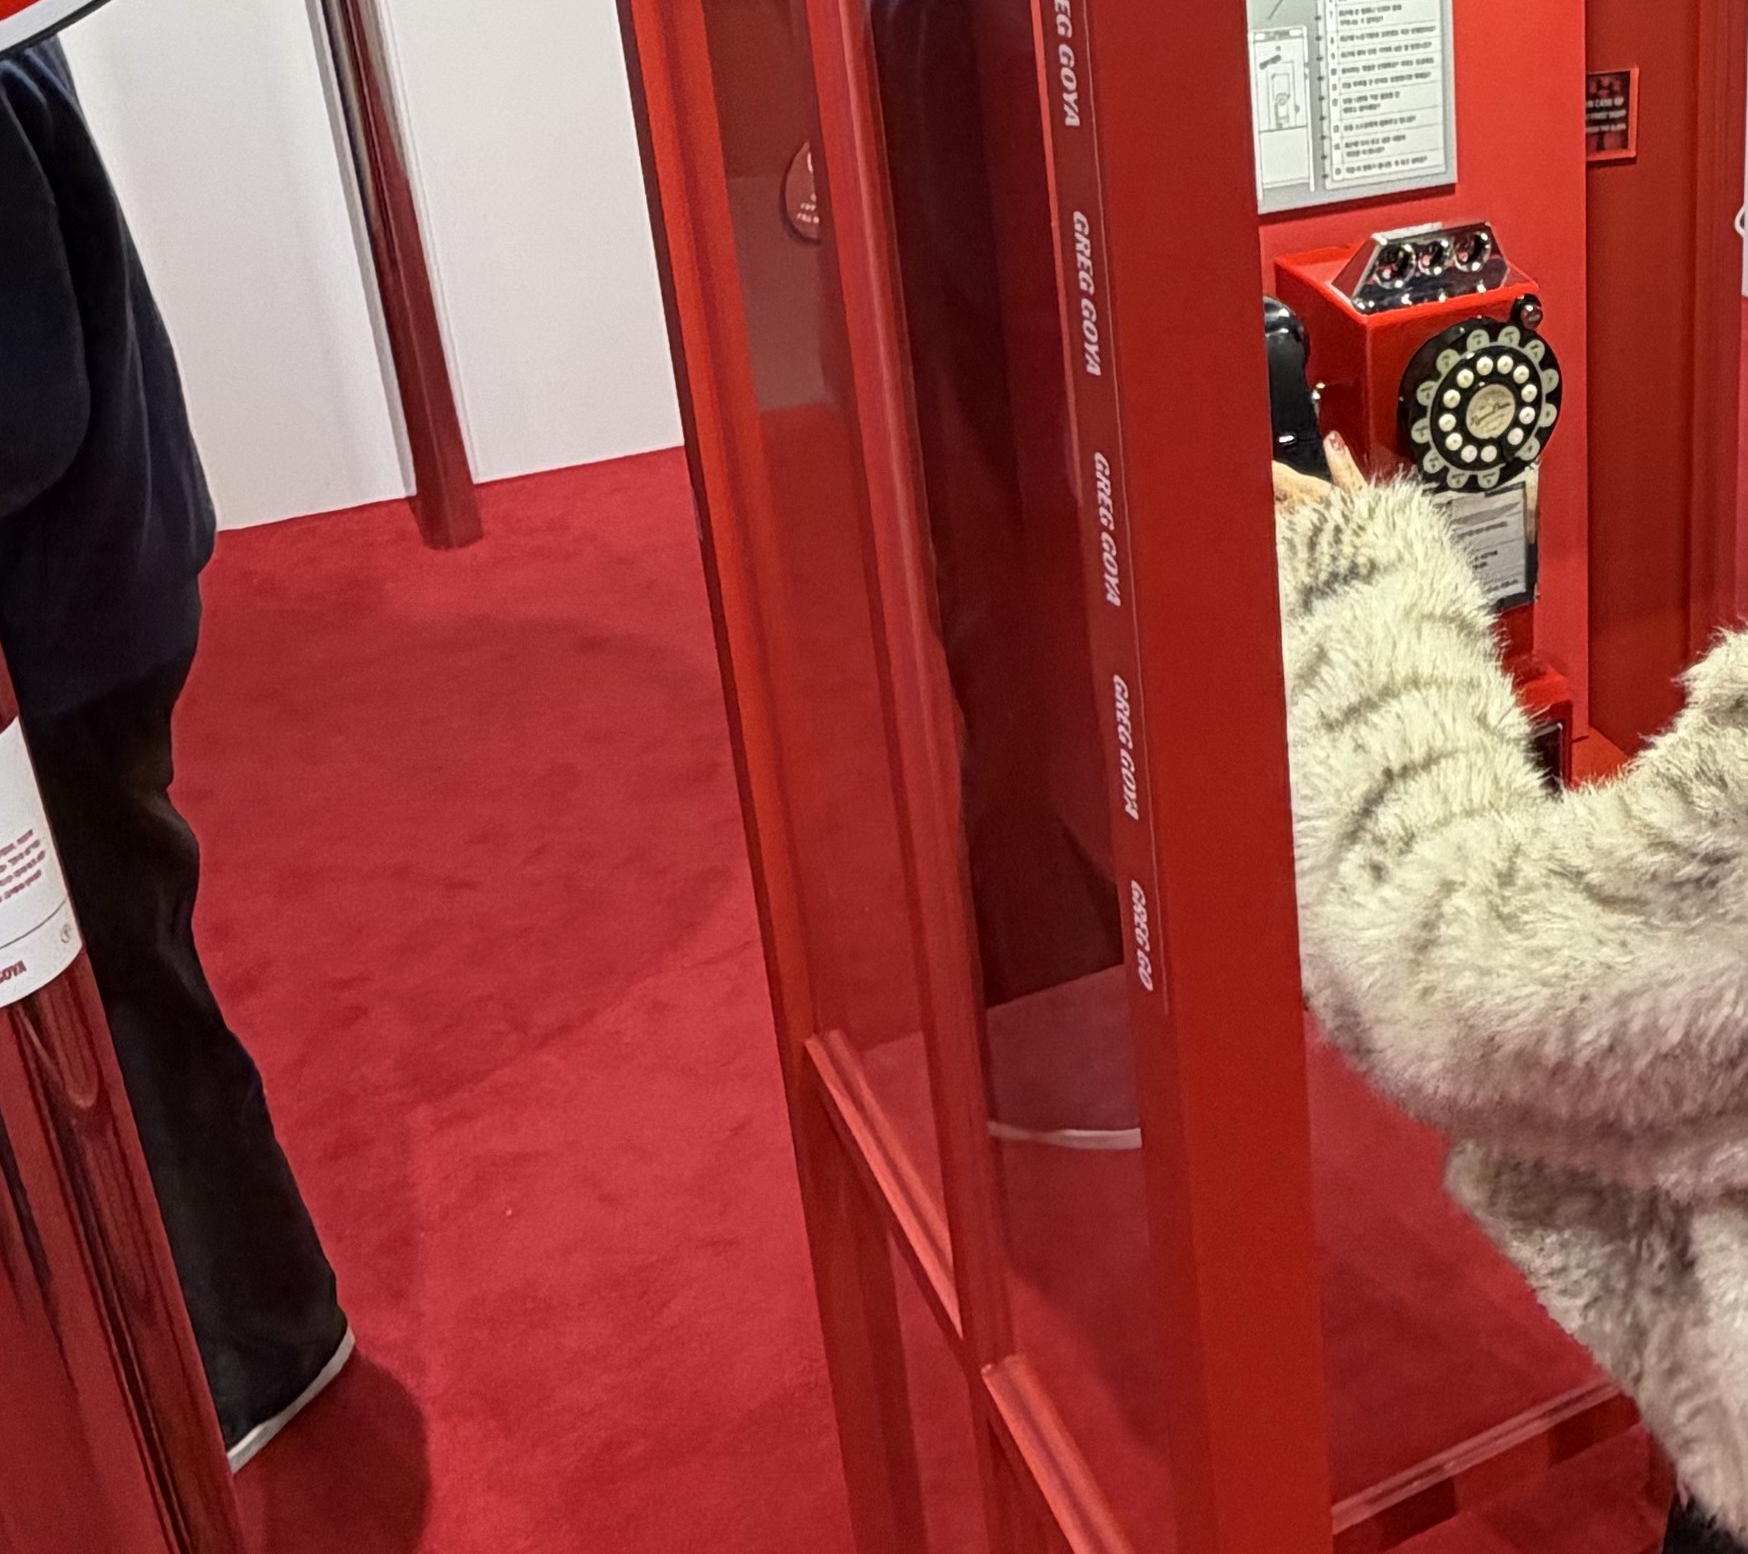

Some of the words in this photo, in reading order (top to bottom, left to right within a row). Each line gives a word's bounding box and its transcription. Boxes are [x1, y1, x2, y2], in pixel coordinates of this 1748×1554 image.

[1058, 44, 1081, 127] GOYA
[1073, 211, 1095, 296] GREG
[1081, 298, 1102, 376] GOYA
[1094, 452, 1115, 532] GREG
[1101, 531, 1122, 607] GOYA
[1113, 674, 1133, 749] GREG
[1120, 748, 1139, 821] GOYA
[1131, 879, 1150, 952] GREG
